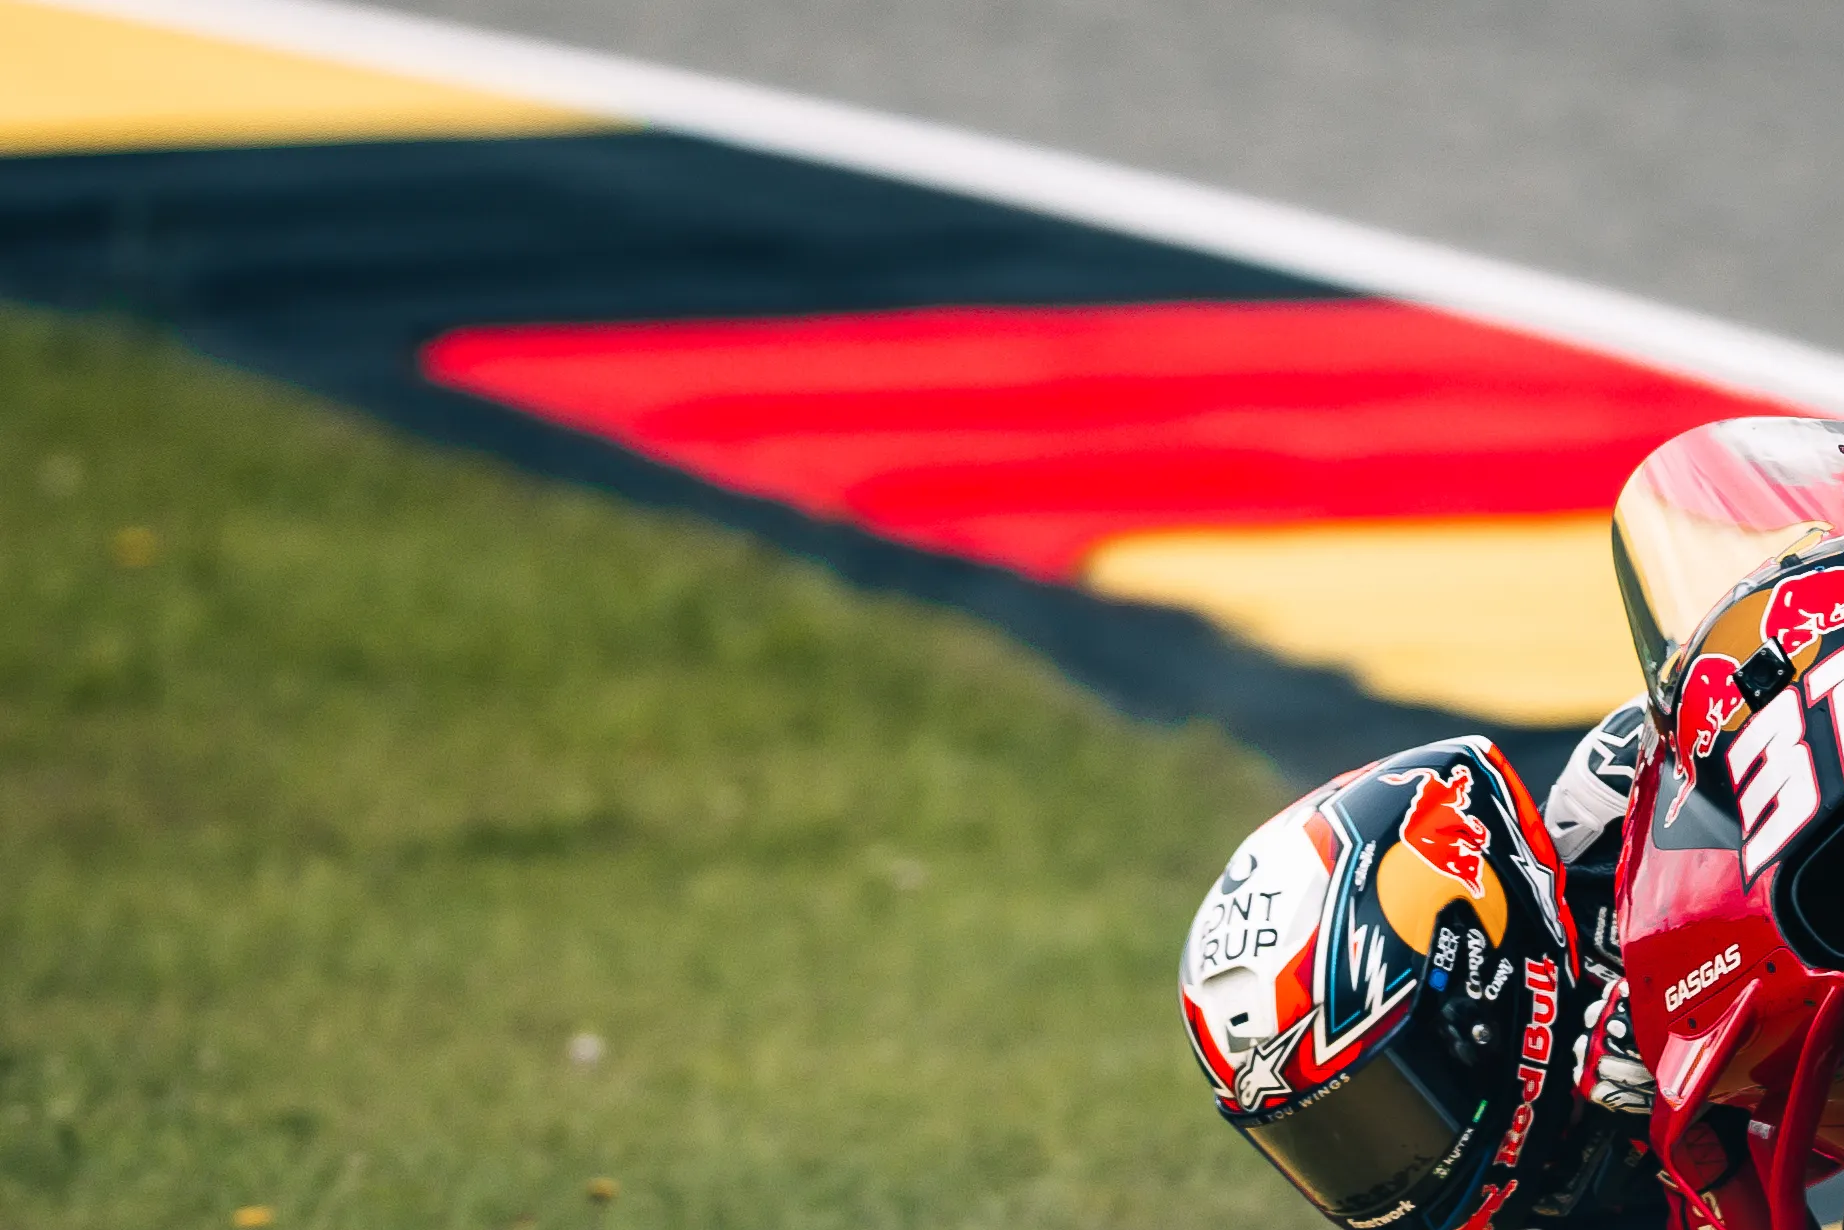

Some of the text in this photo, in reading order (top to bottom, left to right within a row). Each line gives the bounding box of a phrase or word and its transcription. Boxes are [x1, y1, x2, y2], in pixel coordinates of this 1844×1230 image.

[1665, 943, 1741, 1012] GASGAS
[1298, 1072, 1350, 1108] WINGS
[1492, 955, 1558, 1167] Red Bull
